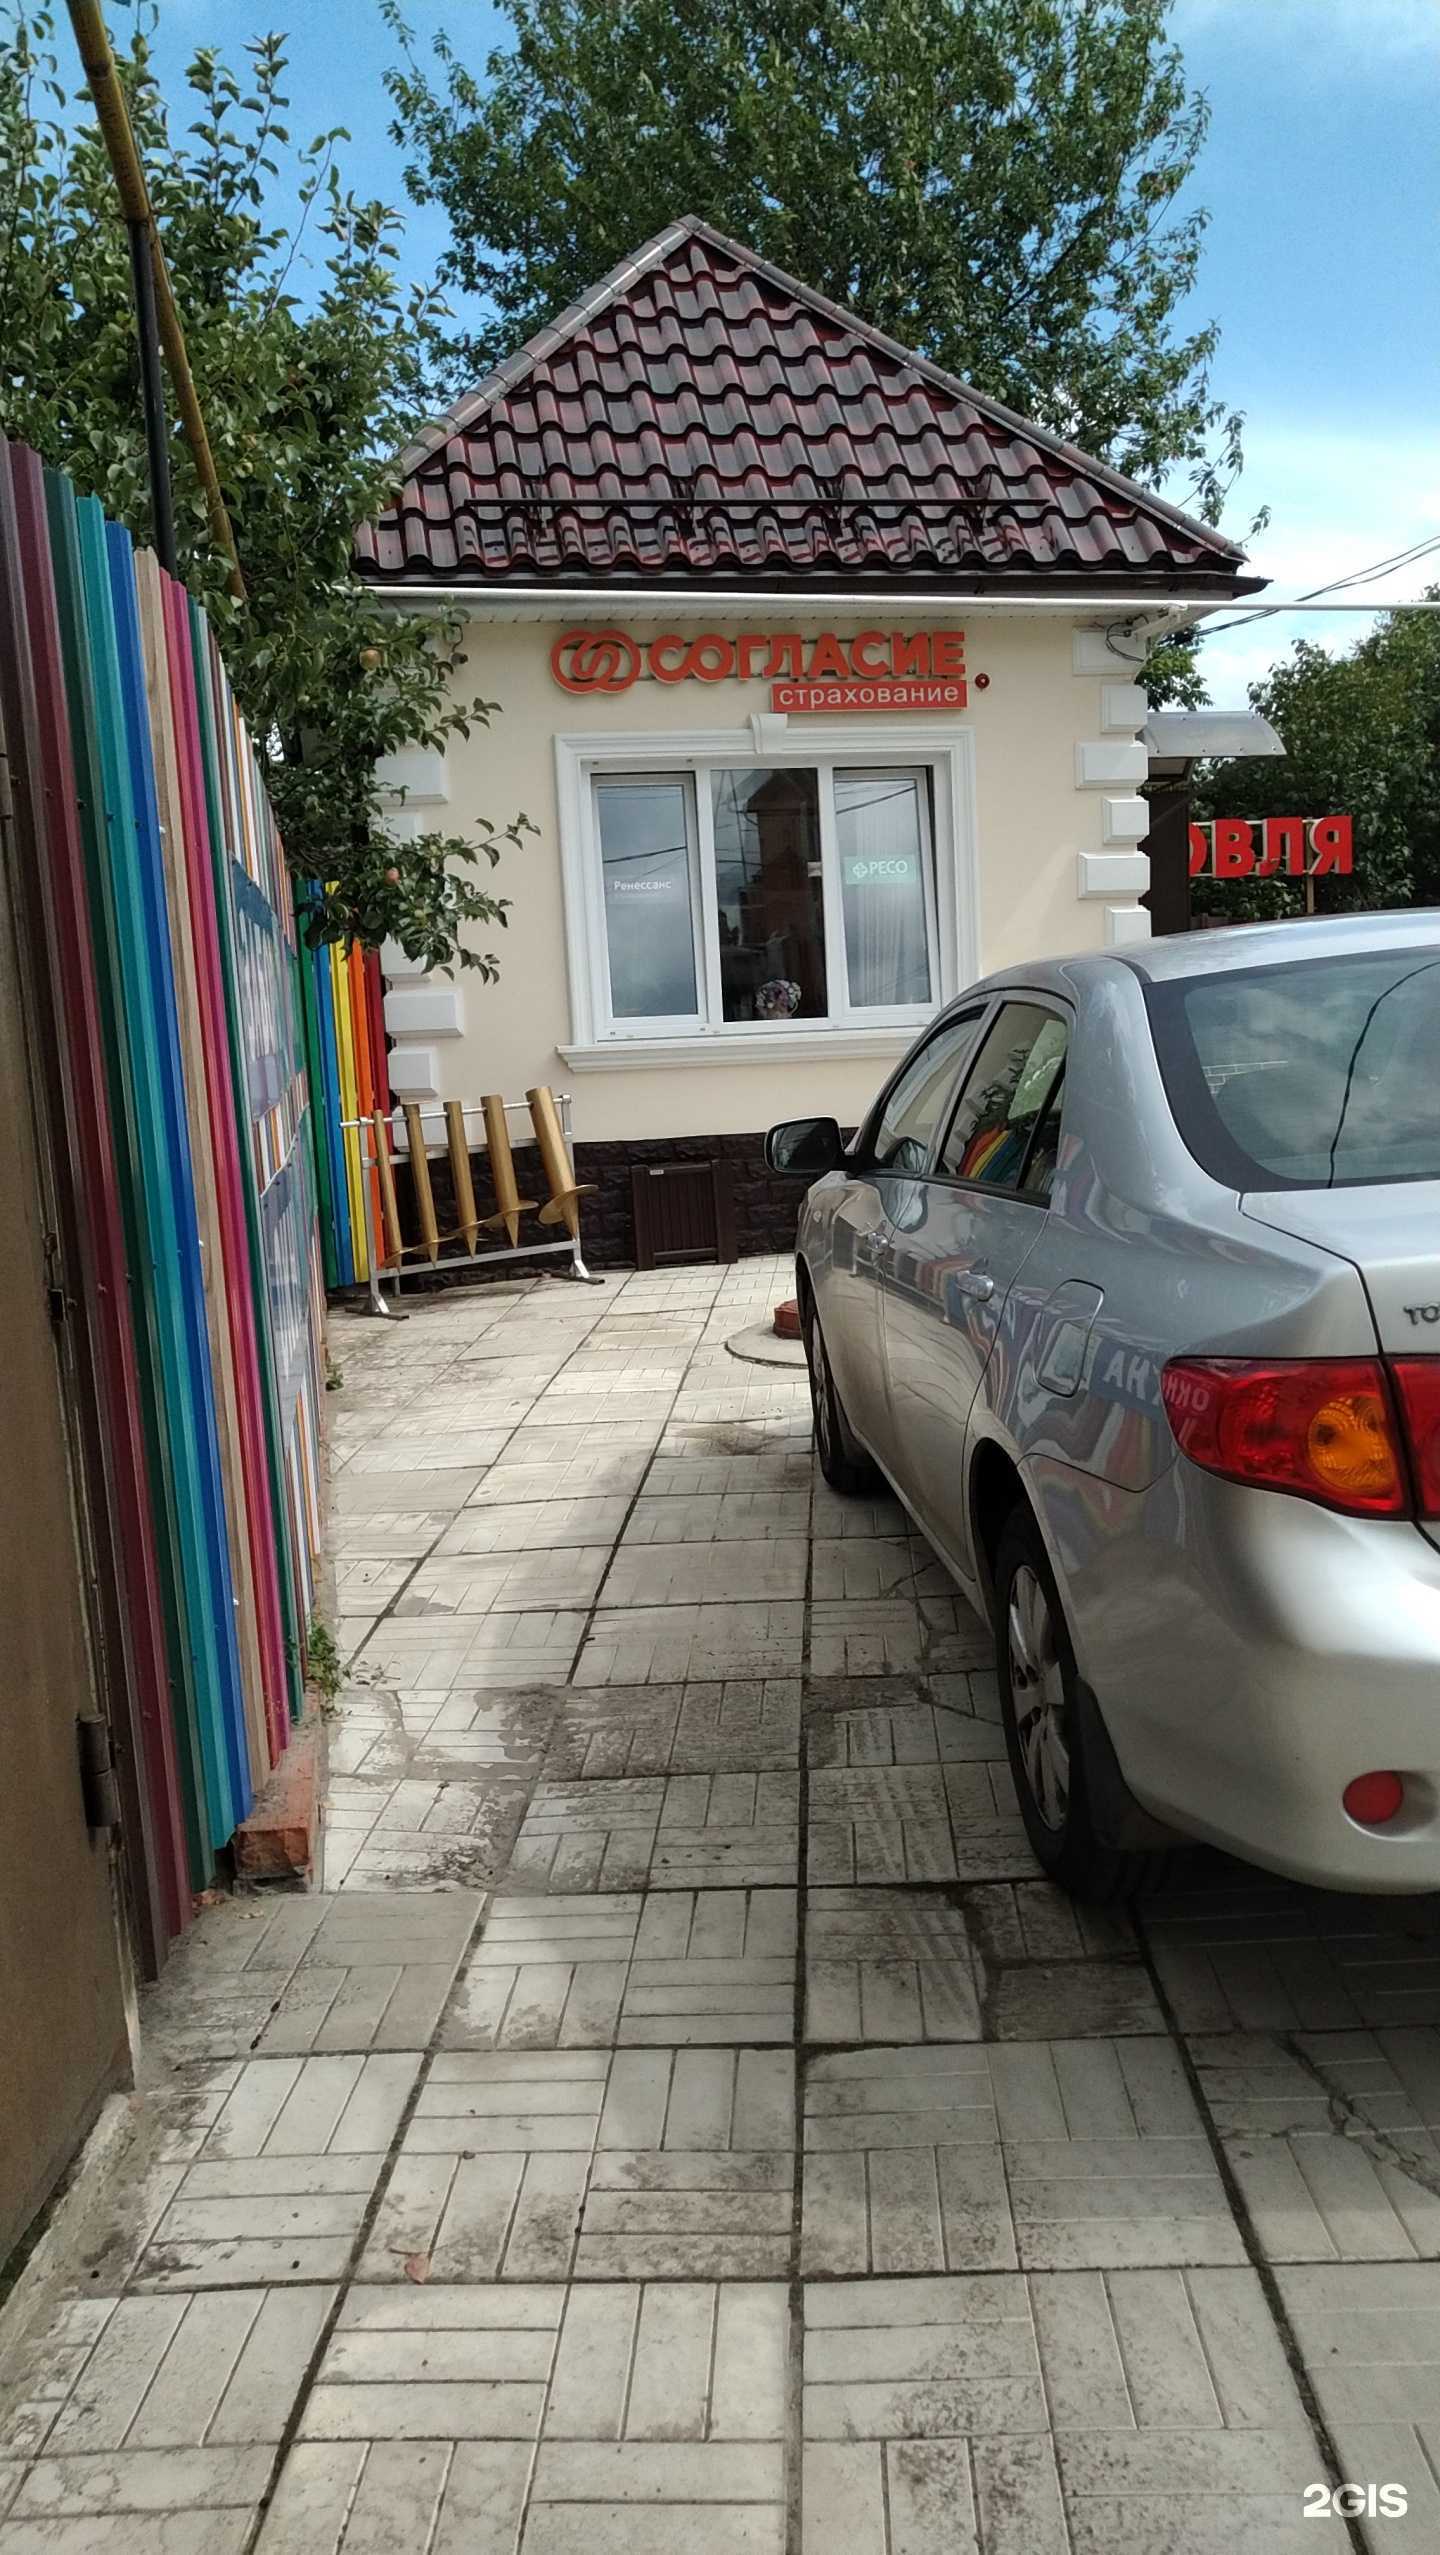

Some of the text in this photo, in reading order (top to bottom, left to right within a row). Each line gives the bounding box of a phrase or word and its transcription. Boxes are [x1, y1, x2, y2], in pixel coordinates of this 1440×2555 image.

[648, 630, 967, 684] СОГЛАСИЕ
[779, 684, 959, 708] страхование
[614, 880, 672, 891] Ренессанс
